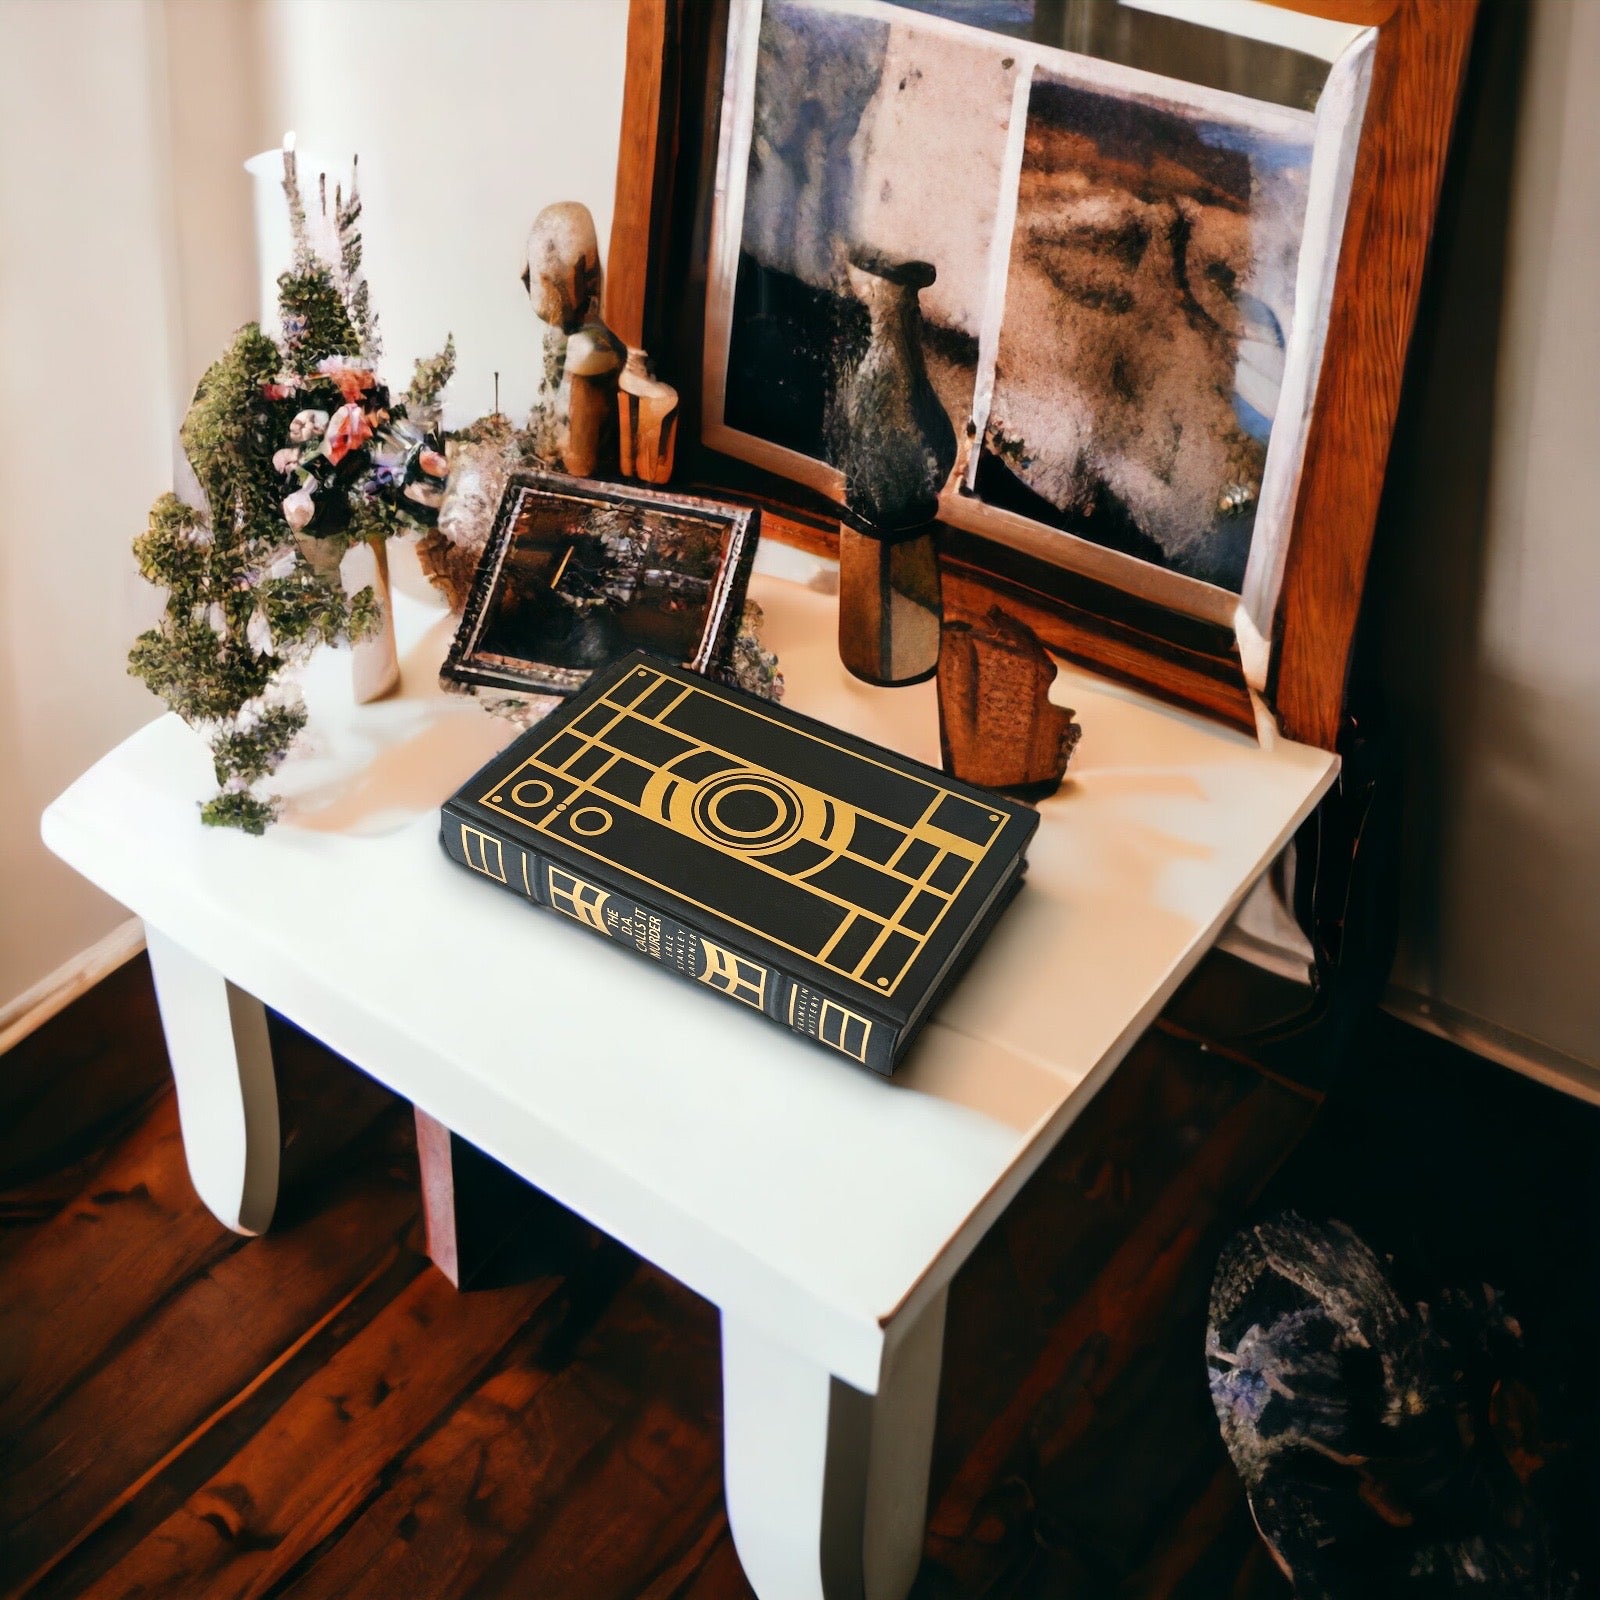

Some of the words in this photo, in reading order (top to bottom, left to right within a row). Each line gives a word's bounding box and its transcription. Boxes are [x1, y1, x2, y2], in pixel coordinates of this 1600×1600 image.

[607, 908, 619, 928] THE
[621, 917, 633, 936] D.A.
[634, 907, 647, 921] IT
[634, 921, 647, 953] CALLS
[649, 916, 661, 960] MURDER
[666, 935, 674, 957] ERLE
[677, 929, 686, 970] STANLEY
[688, 934, 697, 977] GARDNER
[797, 987, 809, 1032] FRANKLIN
[808, 995, 820, 1035] MYSTERY
